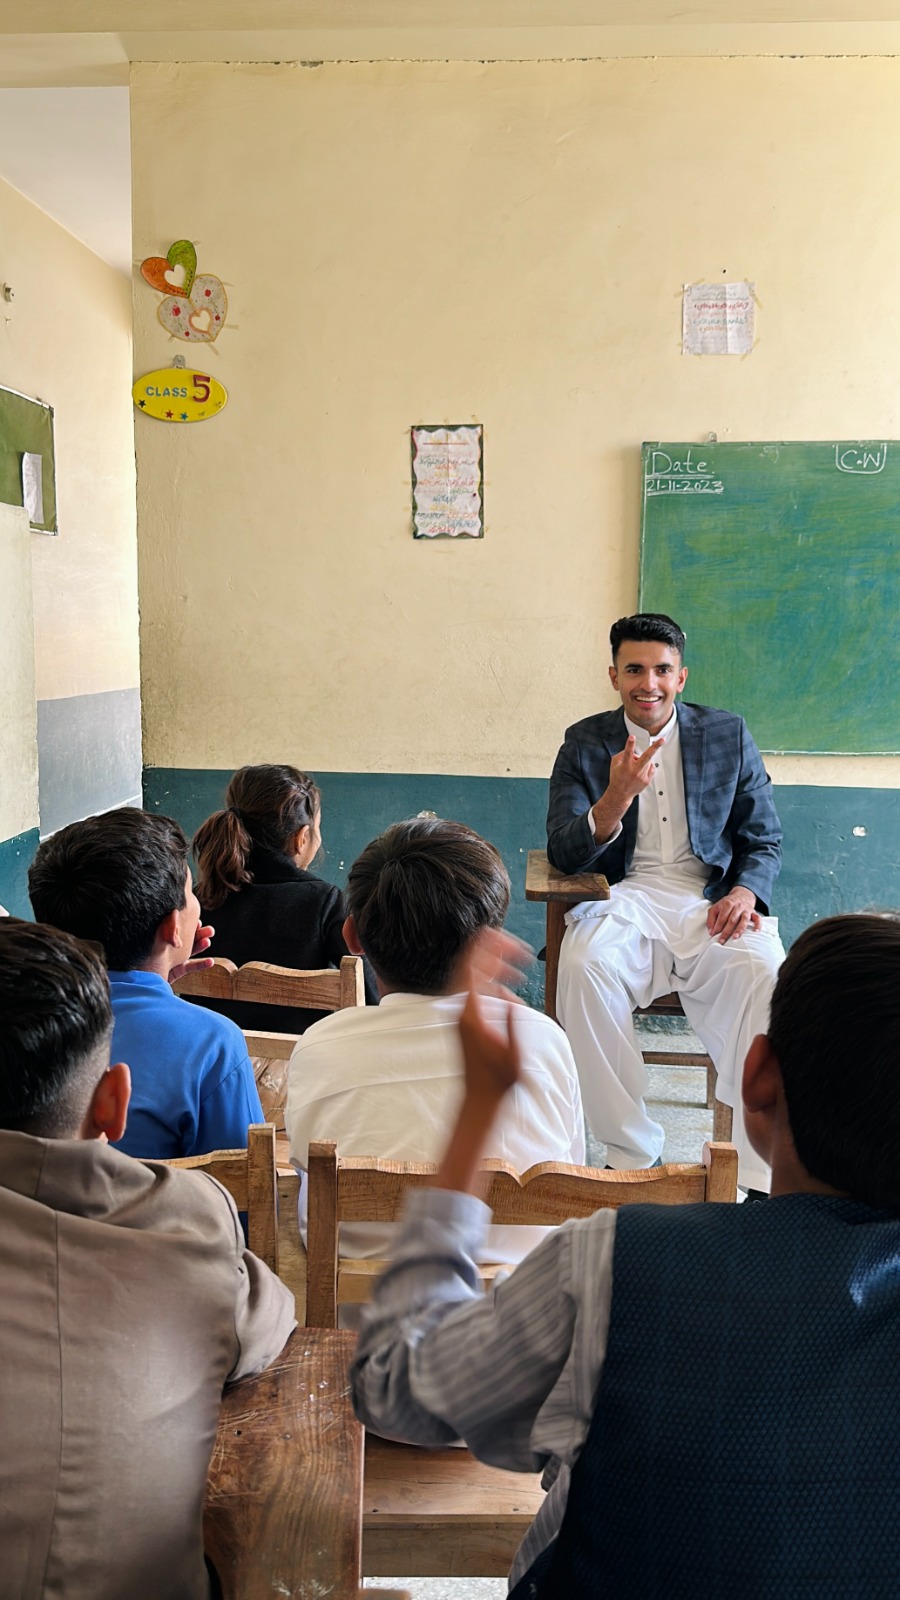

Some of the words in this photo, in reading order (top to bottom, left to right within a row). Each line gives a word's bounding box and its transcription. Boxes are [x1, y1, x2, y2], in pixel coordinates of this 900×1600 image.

[146, 387, 187, 397] CLASS
[193, 375, 210, 402] 5
[645, 479, 724, 493] 21-11-2023
